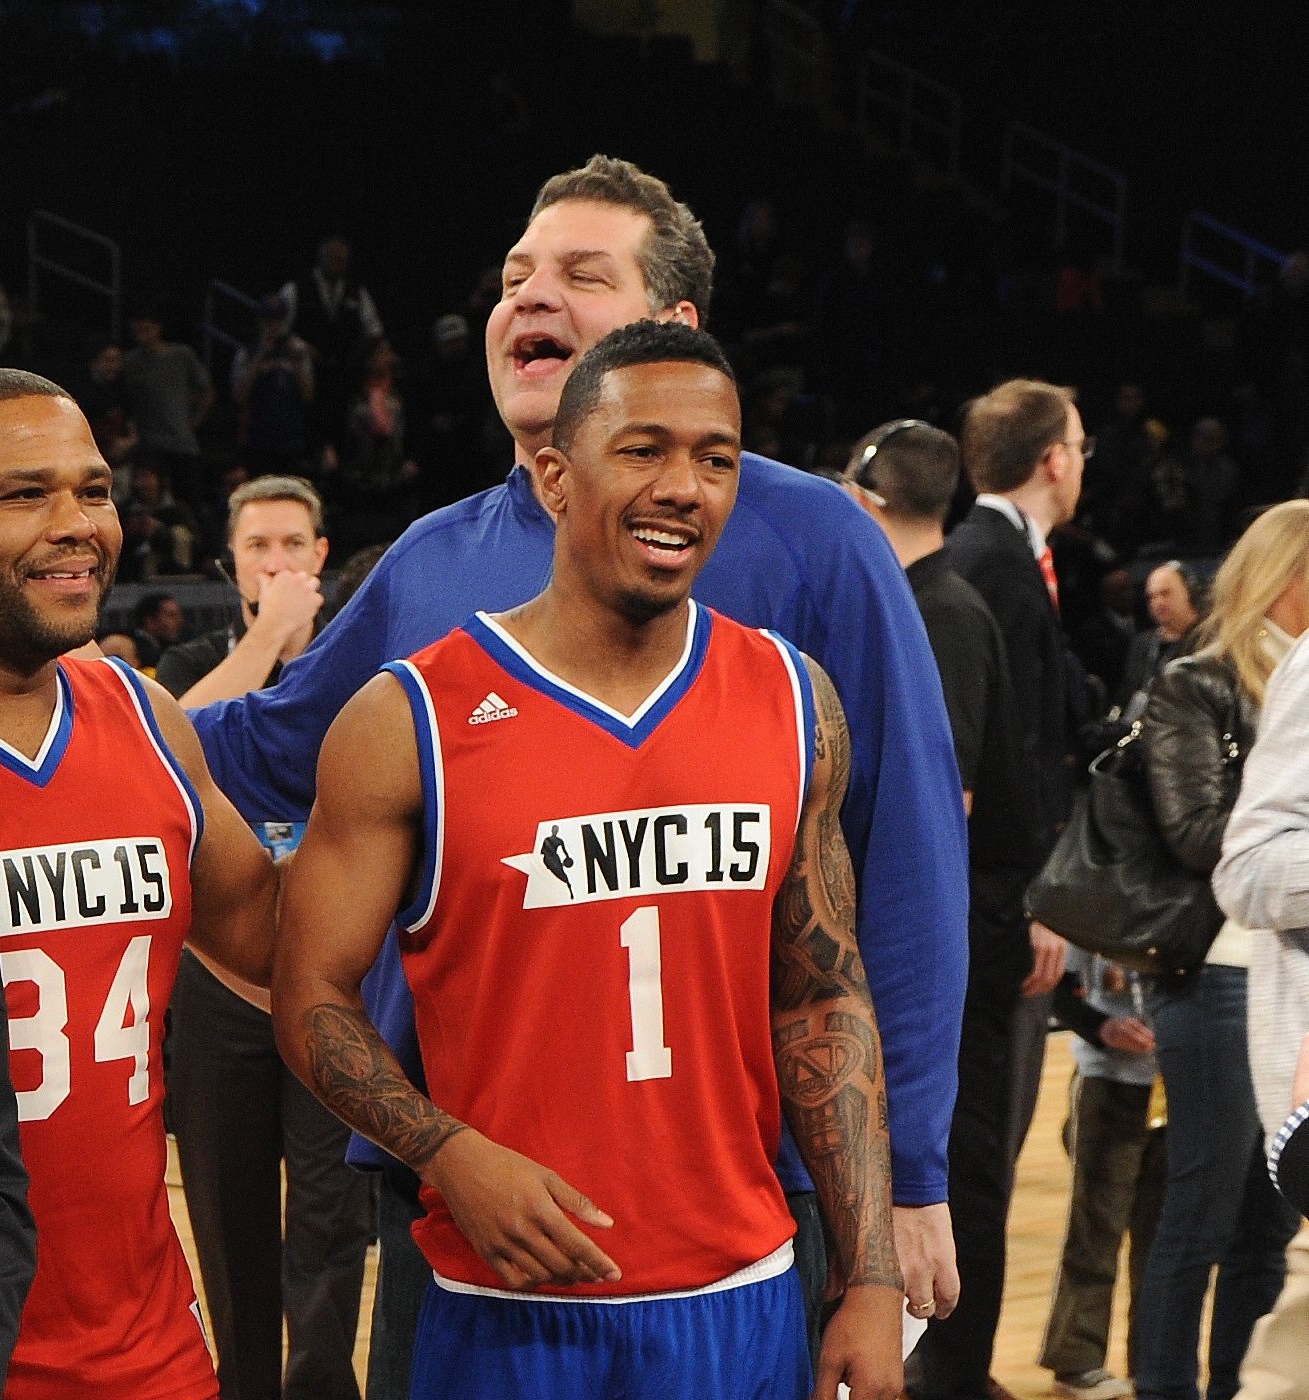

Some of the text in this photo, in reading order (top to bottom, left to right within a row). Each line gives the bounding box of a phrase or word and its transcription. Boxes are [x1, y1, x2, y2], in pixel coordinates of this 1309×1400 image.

[468, 706, 519, 726] adidas
[2, 843, 167, 928] NYC 15
[581, 811, 760, 894] NYC 15
[619, 905, 672, 1082] 1
